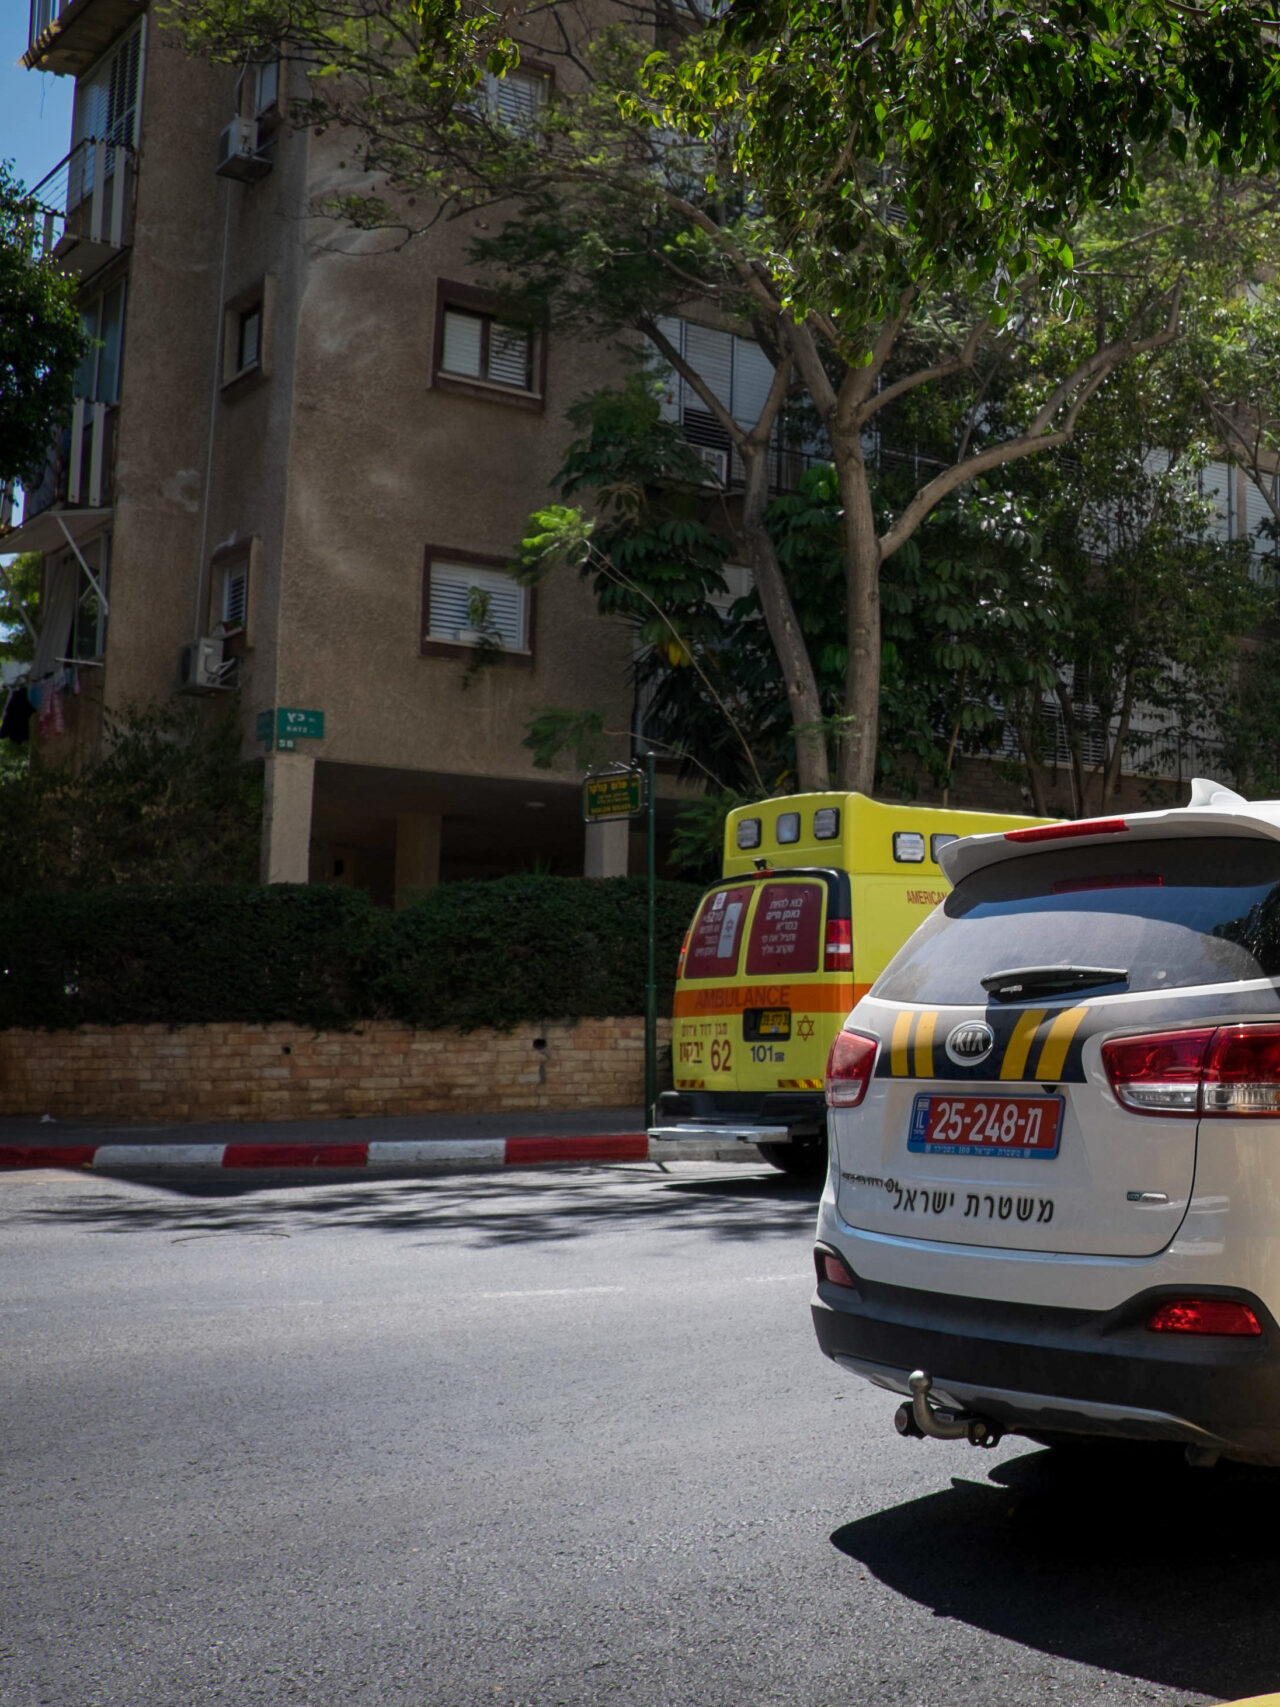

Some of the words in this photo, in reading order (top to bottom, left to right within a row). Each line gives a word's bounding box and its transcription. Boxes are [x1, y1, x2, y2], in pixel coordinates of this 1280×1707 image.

[287, 712, 305, 723] כץ
[695, 984, 791, 1009] AMBULANCE
[681, 1024, 697, 1037] אדום
[700, 1023, 712, 1036] דוד
[715, 1022, 728, 1037] מגן
[955, 1031, 984, 1052] KIA
[679, 1041, 704, 1063] ירקון
[711, 1039, 732, 1072] 62
[750, 1045, 773, 1062] 101
[916, 1111, 925, 1129] IL
[958, 1146, 971, 1154] 100
[893, 1182, 955, 1214] ישראל
[964, 1194, 1054, 1223] משטרת
